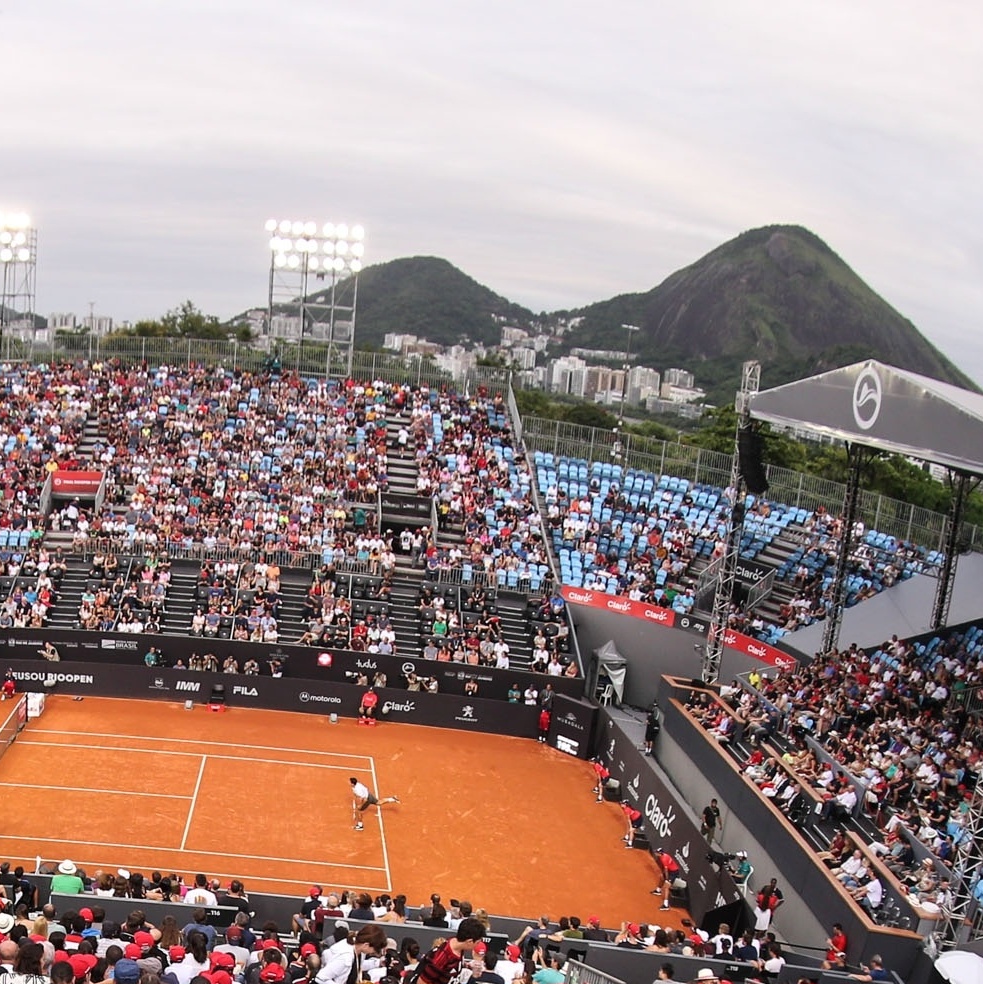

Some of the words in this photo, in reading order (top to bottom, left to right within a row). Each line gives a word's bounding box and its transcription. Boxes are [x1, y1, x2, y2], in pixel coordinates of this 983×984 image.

[735, 566, 763, 580] Claro
[569, 592, 593, 603] Claro
[607, 600, 631, 611] Claro
[645, 609, 667, 621] Claro
[747, 644, 766, 657] Claro
[355, 659, 377, 669] tudus
[175, 680, 200, 692] IMM
[233, 686, 258, 696] FILA
[310, 694, 341, 704] motorola
[384, 700, 415, 712] Claro
[627, 781, 640, 801] Santander
[645, 794, 676, 838] Claro
[674, 849, 690, 874] Santander
